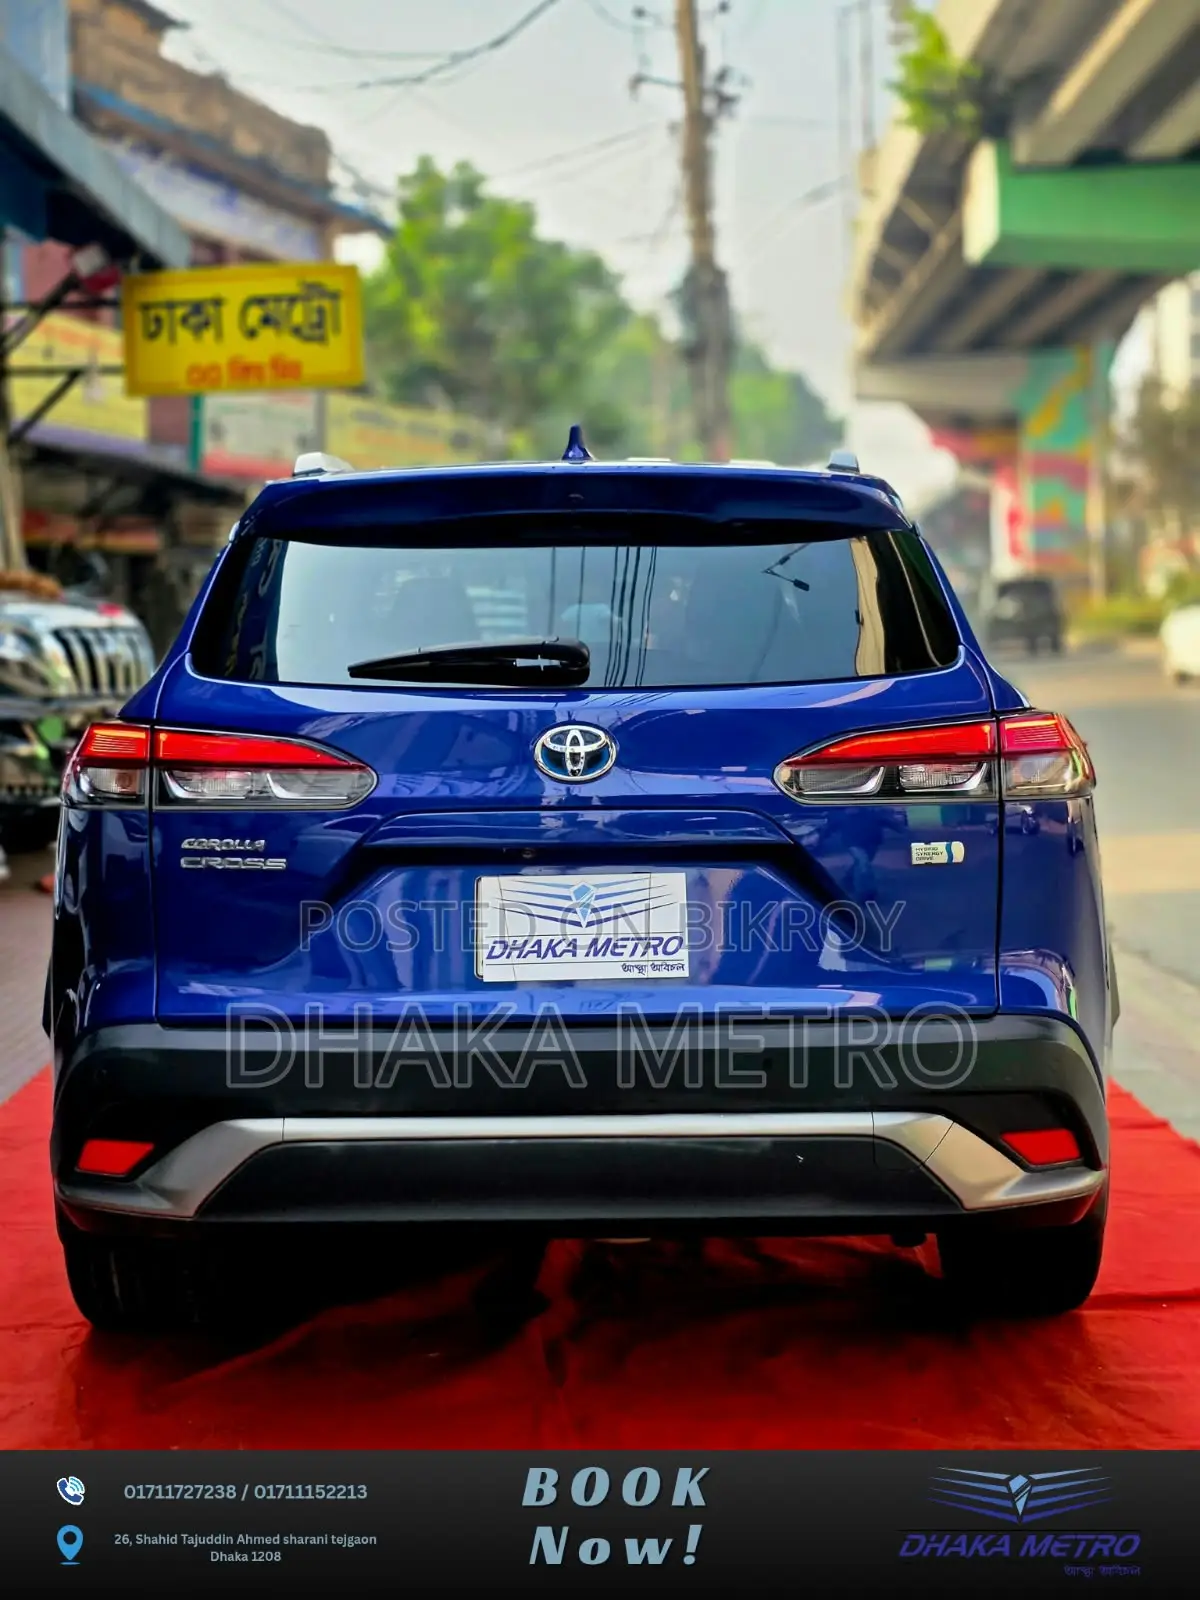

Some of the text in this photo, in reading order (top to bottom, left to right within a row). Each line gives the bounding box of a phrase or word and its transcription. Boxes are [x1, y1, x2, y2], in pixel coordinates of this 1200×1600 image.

[139, 296, 224, 344] ঢাকা
[238, 281, 341, 347] মেট্রো
[181, 838, 265, 851] COROLLA
[181, 857, 287, 869] CROSS
[486, 935, 684, 960] DHAKA METRO
